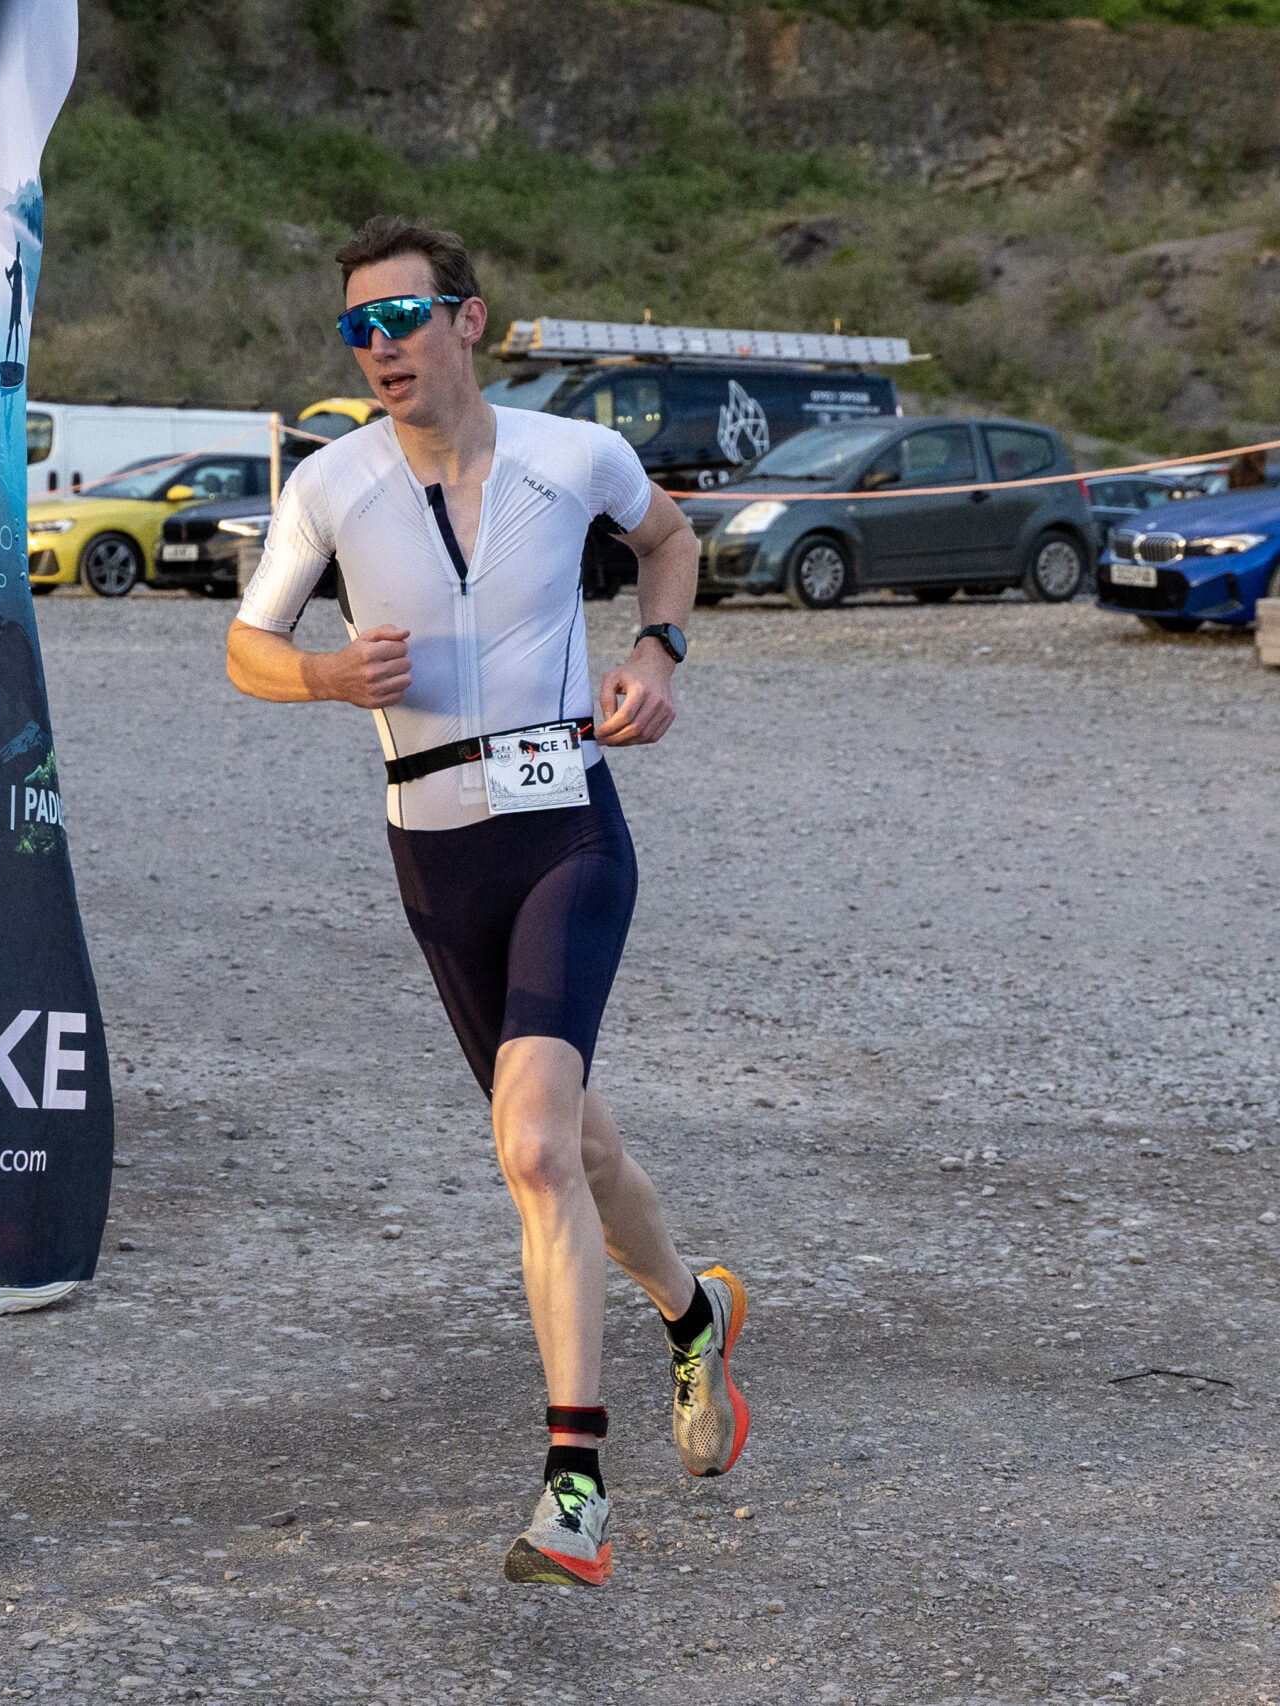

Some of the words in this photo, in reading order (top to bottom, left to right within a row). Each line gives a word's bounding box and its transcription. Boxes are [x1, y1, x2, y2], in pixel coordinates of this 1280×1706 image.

[522, 475, 557, 502] HUUB
[562, 739, 569, 750] 1
[519, 762, 554, 786] 20
